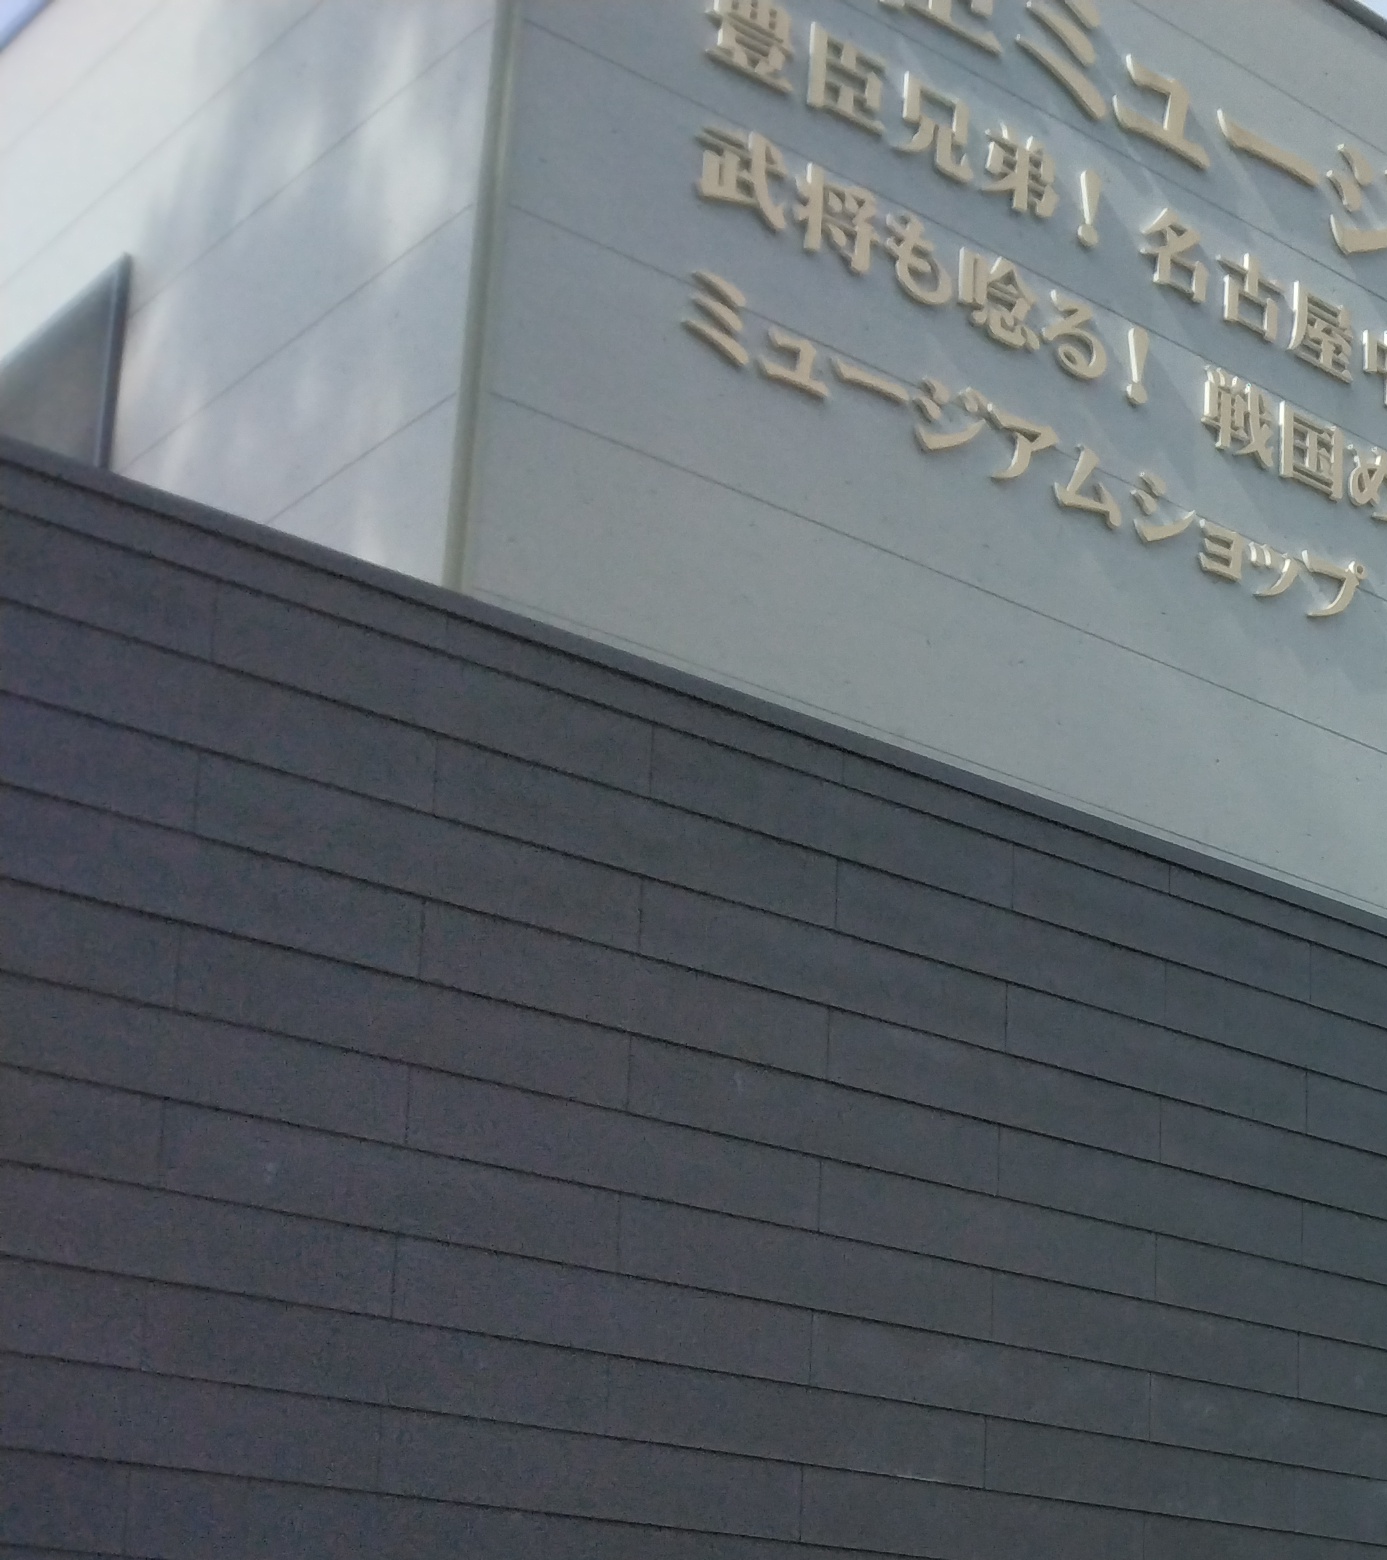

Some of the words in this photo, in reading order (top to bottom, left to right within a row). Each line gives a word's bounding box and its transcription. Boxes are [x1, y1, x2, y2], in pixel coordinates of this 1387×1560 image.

[682, 271, 1368, 618] ミュージアムショップ
